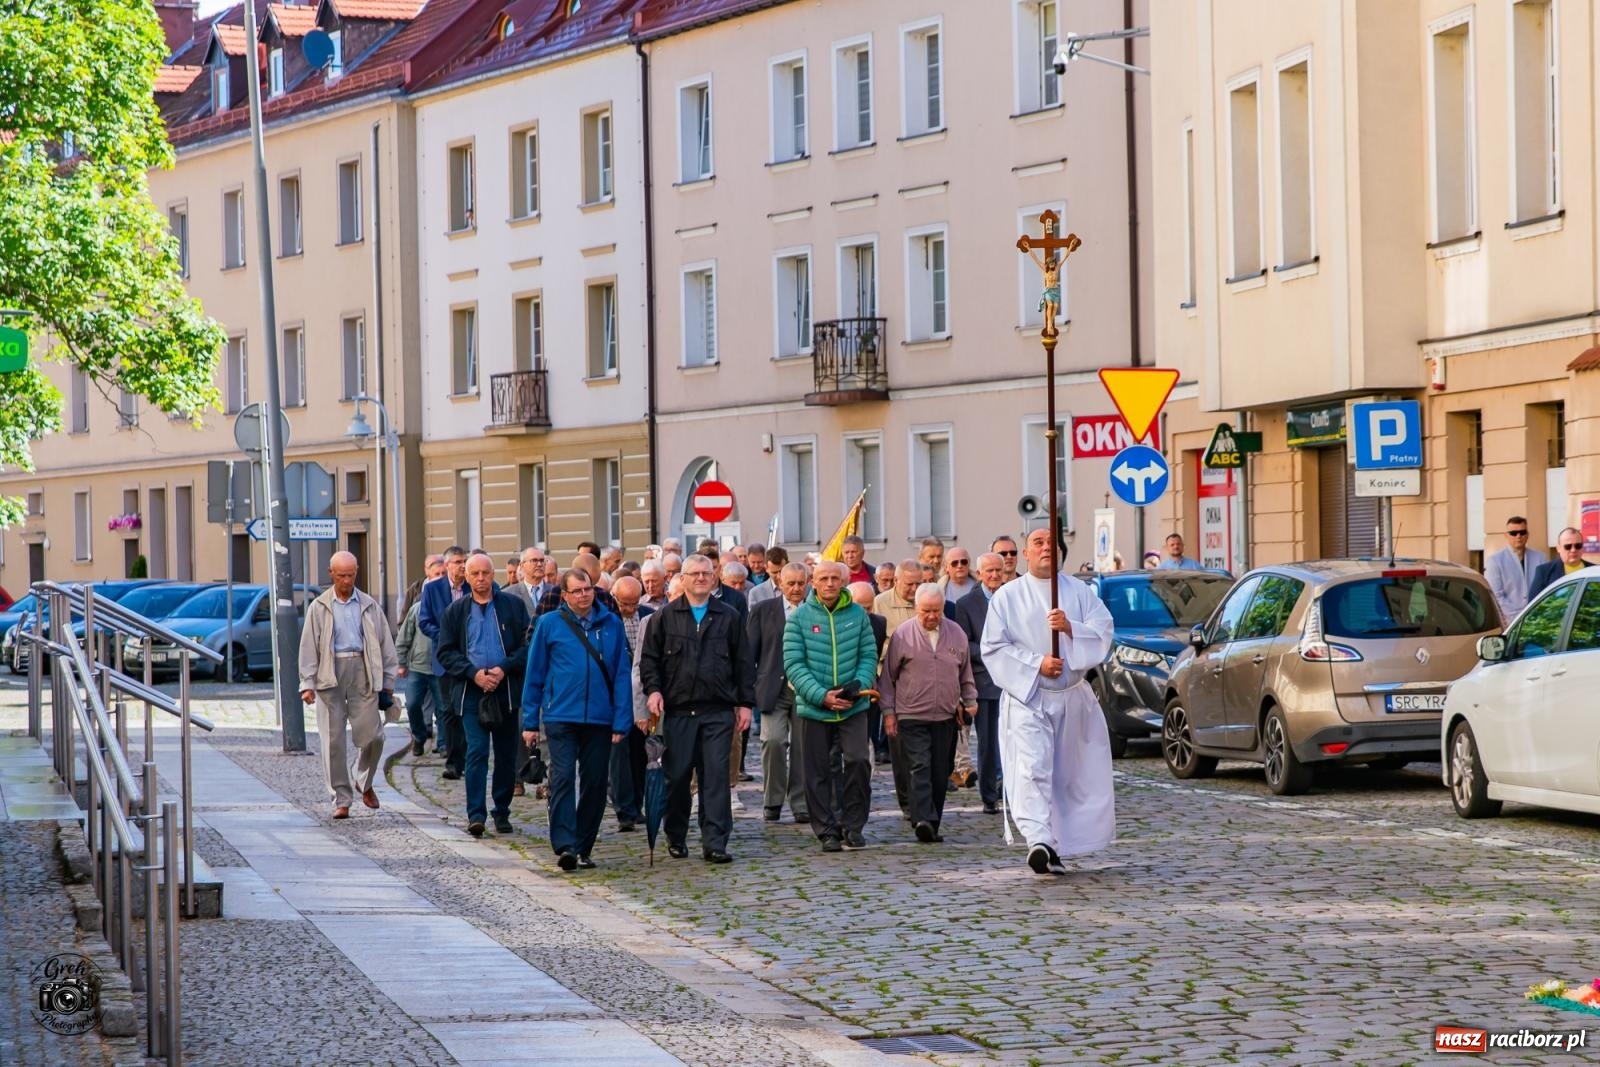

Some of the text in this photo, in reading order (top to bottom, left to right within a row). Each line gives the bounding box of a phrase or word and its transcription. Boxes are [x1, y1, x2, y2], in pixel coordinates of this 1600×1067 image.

[1369, 409, 1407, 461] P
[1210, 453, 1241, 465] ABC
[1369, 478, 1406, 488] Koniec
[1206, 507, 1222, 524] OKNA
[1395, 695, 1419, 710] SRC
